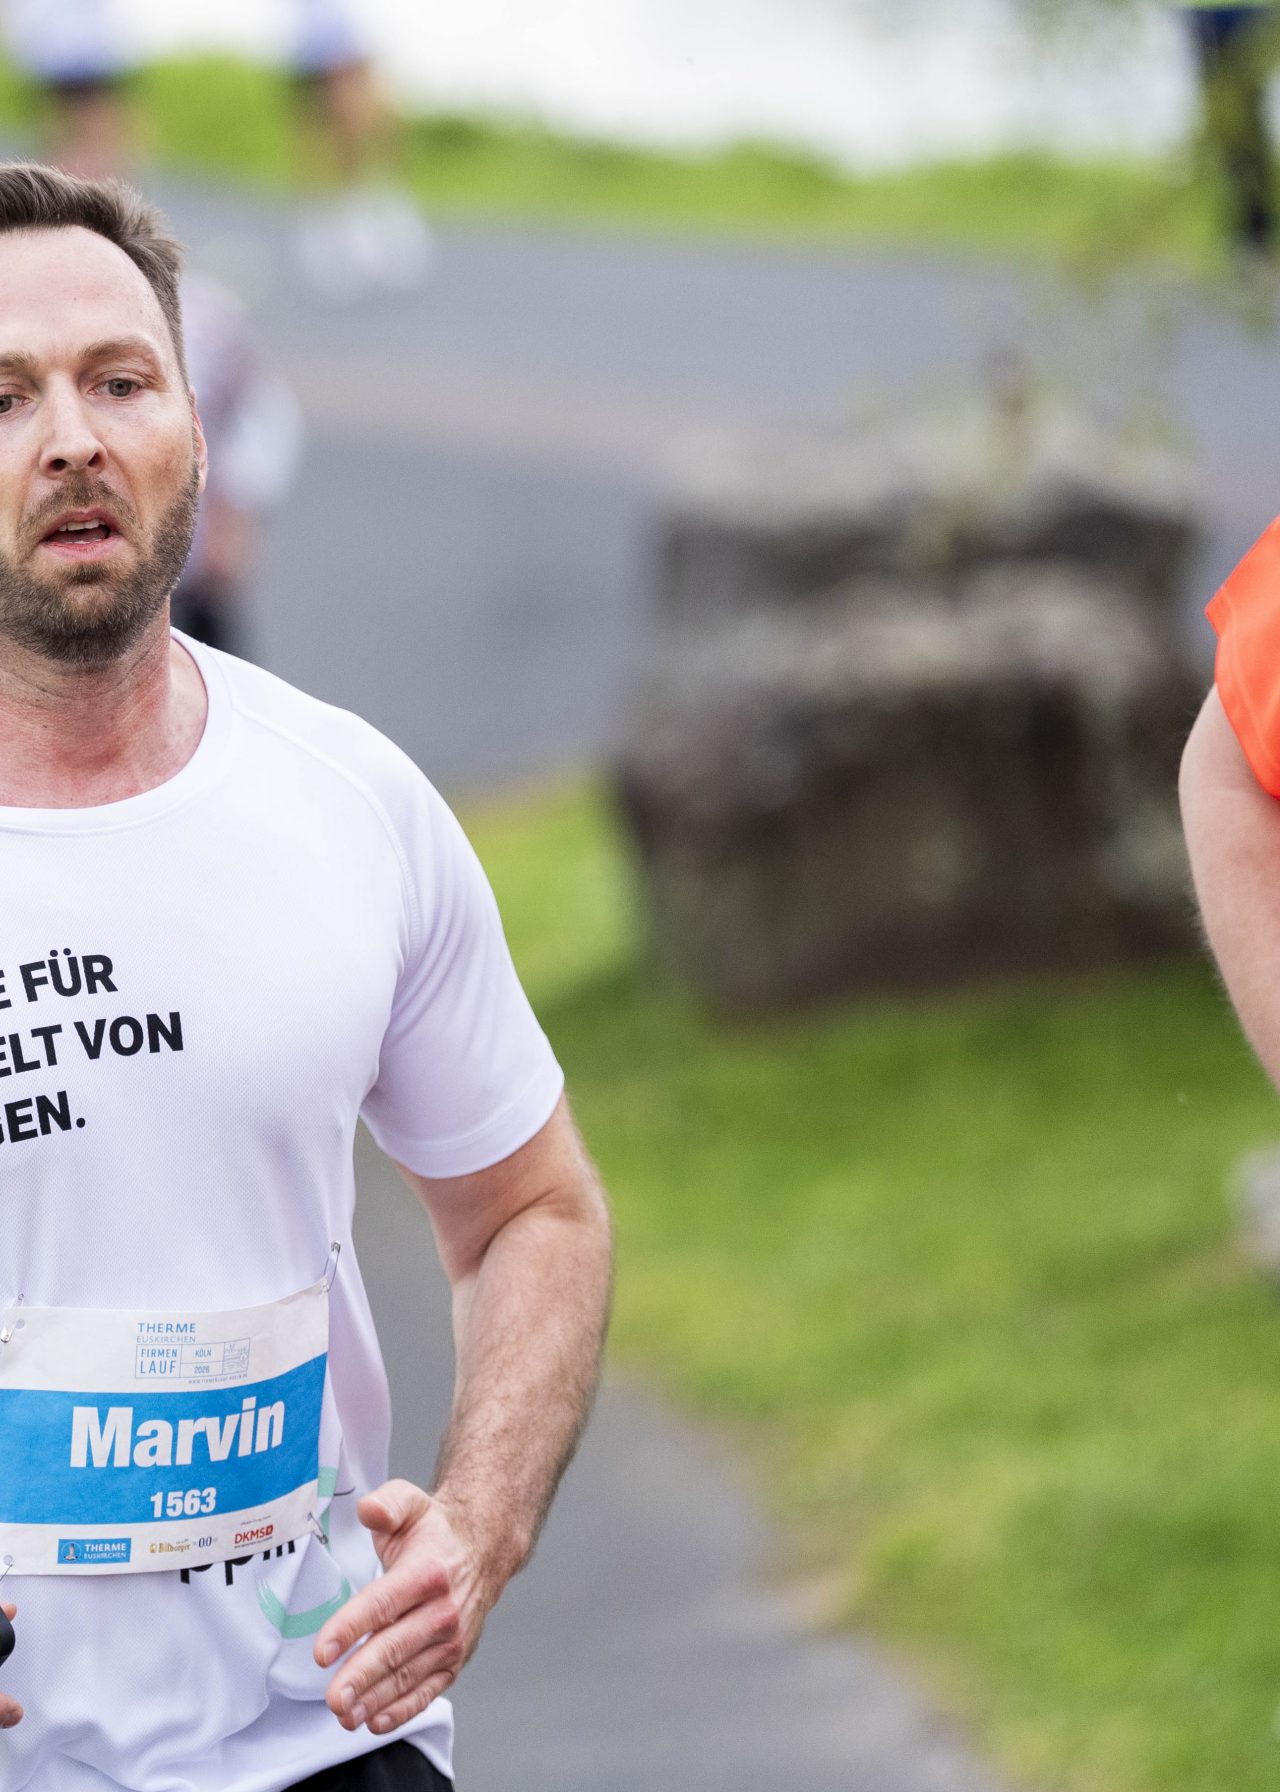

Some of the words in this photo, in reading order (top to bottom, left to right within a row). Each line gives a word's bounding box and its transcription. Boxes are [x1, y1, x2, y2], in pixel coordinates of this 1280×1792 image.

[19, 947, 119, 1003] FÜR
[73, 1011, 184, 1060] VON
[137, 1322, 196, 1333] THERME
[136, 1335, 196, 1344] EUSKIRCHEN
[140, 1348, 178, 1358] FIRMEN
[194, 1349, 212, 1358] KÖLN
[140, 1360, 176, 1375] LAUF
[70, 1396, 285, 1468] Marvin
[150, 1486, 217, 1518] 1563
[84, 1543, 127, 1552] THERME
[84, 1552, 127, 1560] EUSKIRCHEN
